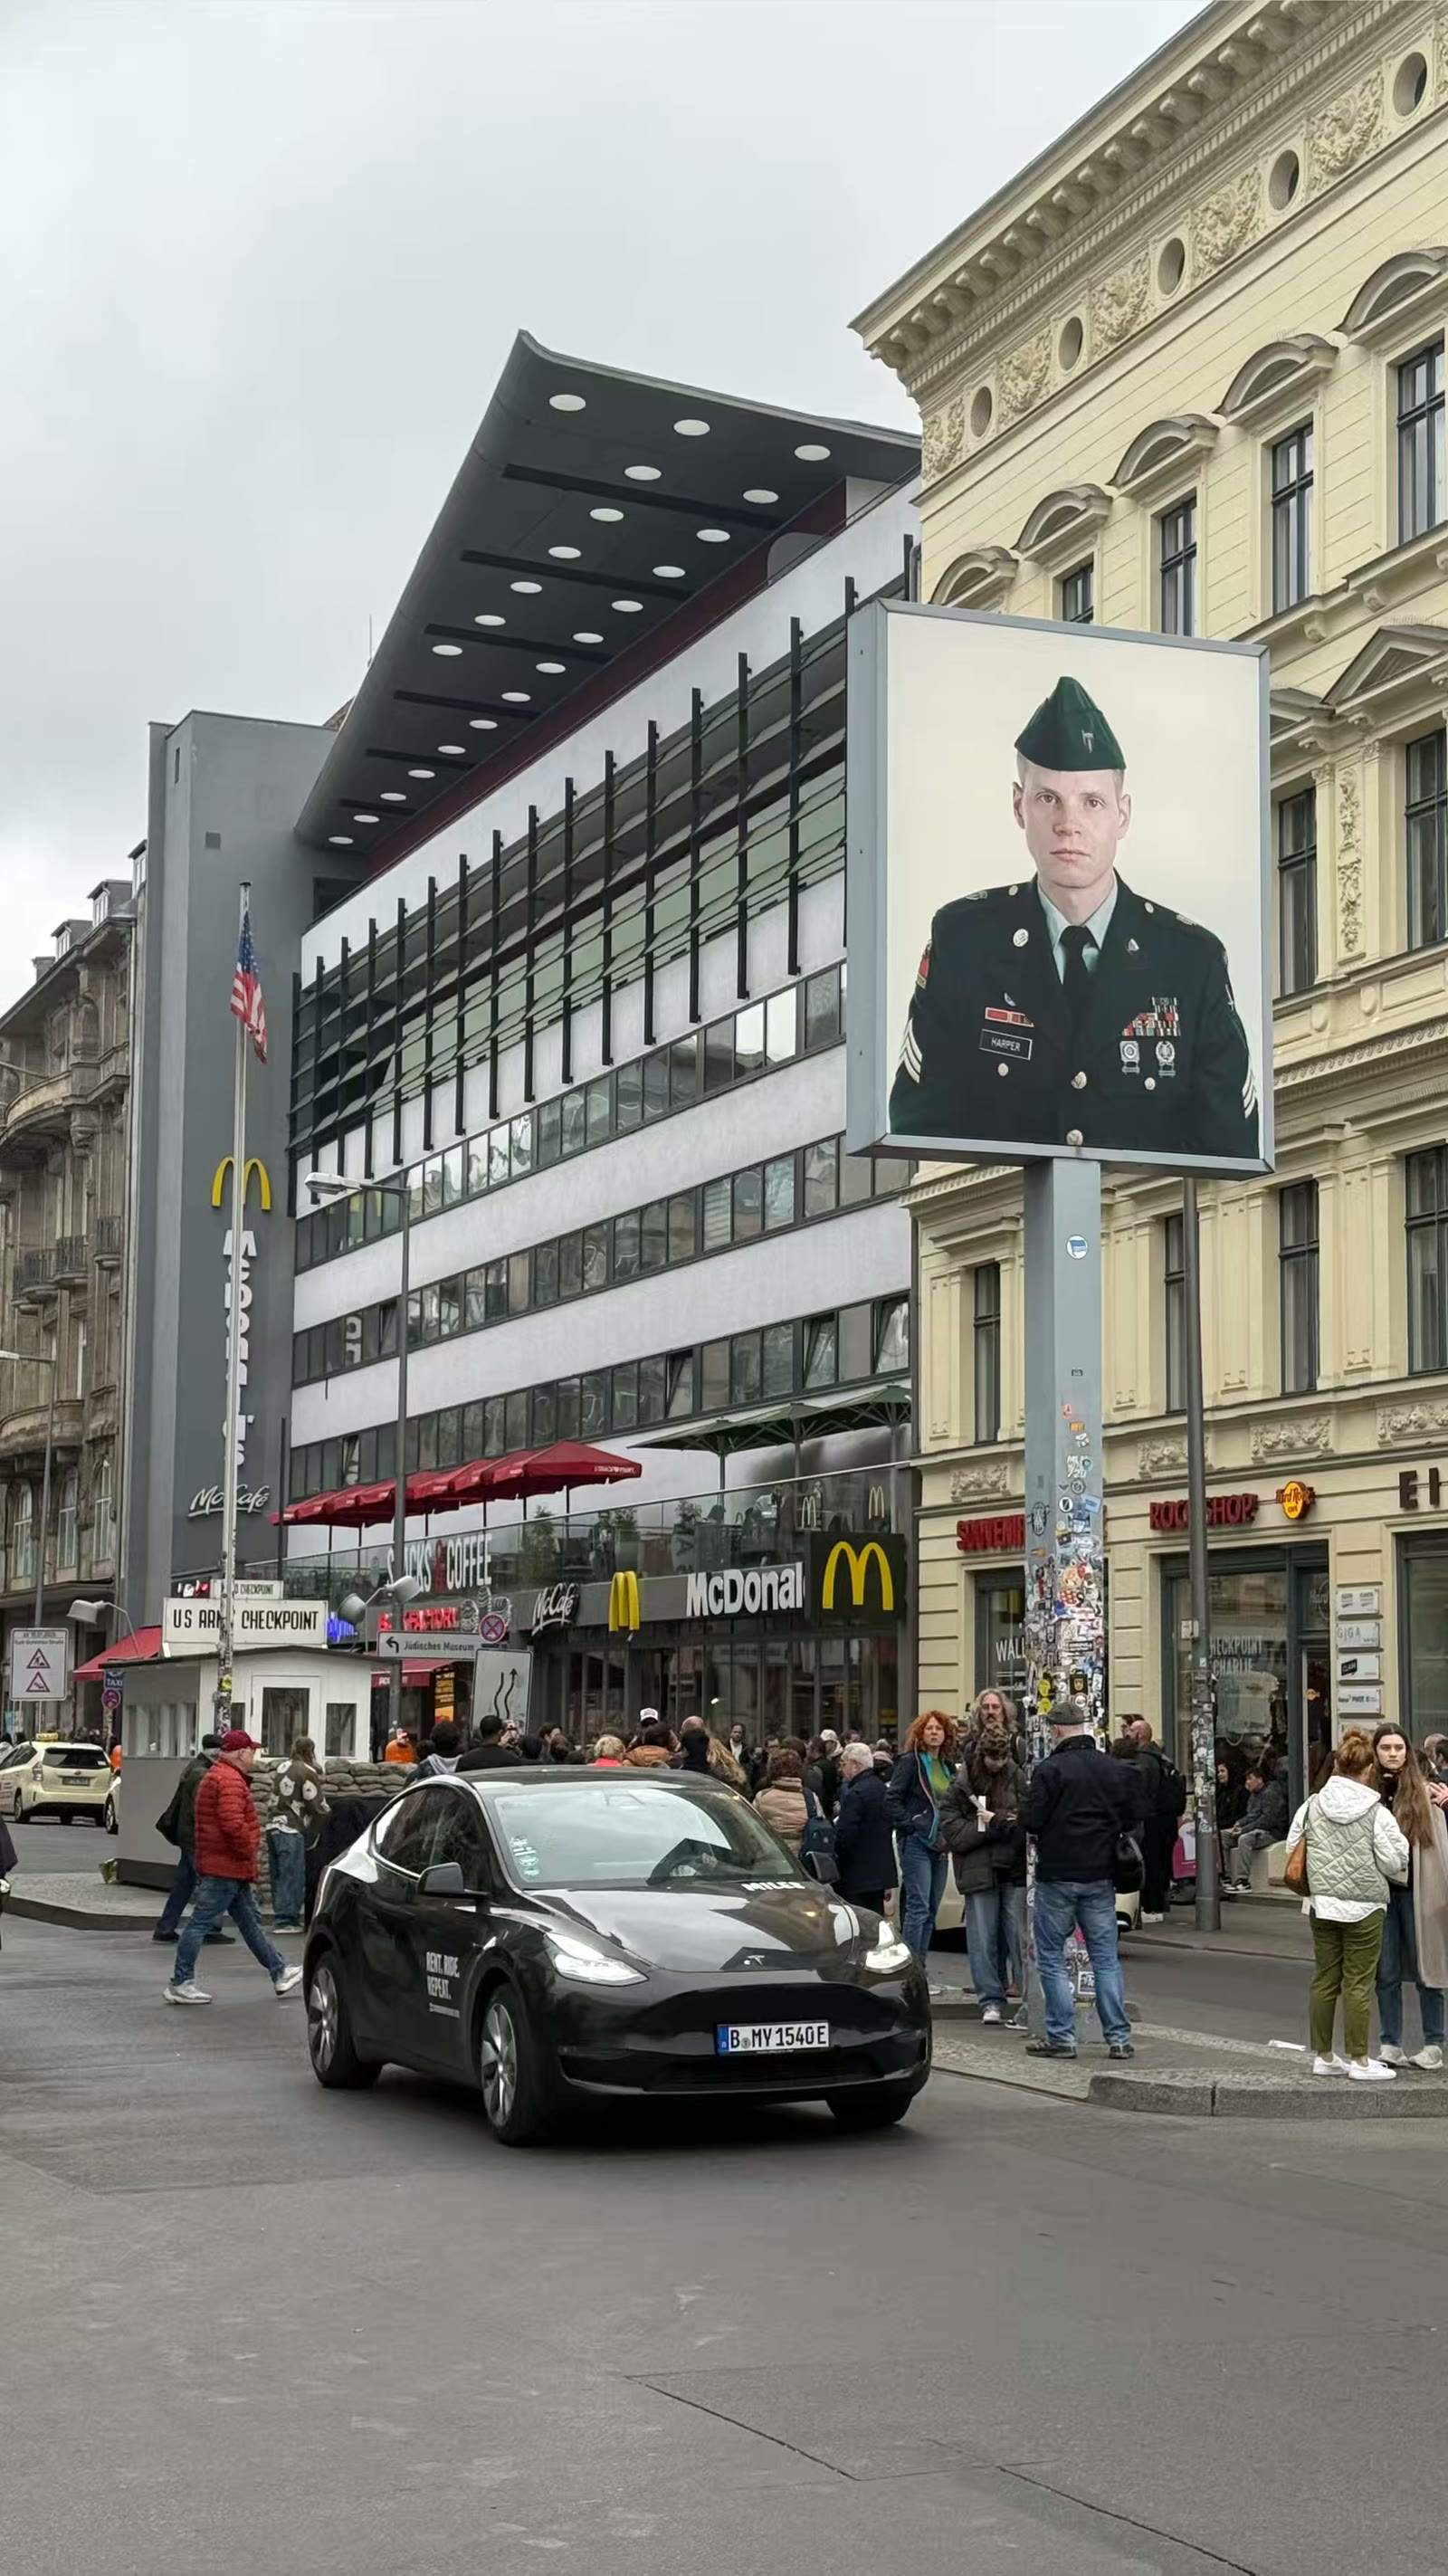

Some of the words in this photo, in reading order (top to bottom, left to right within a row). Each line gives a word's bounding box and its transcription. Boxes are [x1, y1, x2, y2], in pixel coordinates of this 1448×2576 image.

[991, 1037, 1021, 1052] HARPER
[1150, 1500, 1189, 1531] ROC
[447, 1533, 492, 1590] COFFEE
[241, 1583, 274, 1595] CHECKPOINT
[686, 1562, 805, 1617] McDonal
[532, 1583, 577, 1632] McCafé
[242, 1610, 319, 1630] CHECKPOINT
[404, 1640, 441, 1651] Jüdisches
[443, 1641, 475, 1652] Museum
[741, 1882, 805, 1892] MILES
[730, 2029, 740, 2049] B
[752, 2027, 773, 2048] MY
